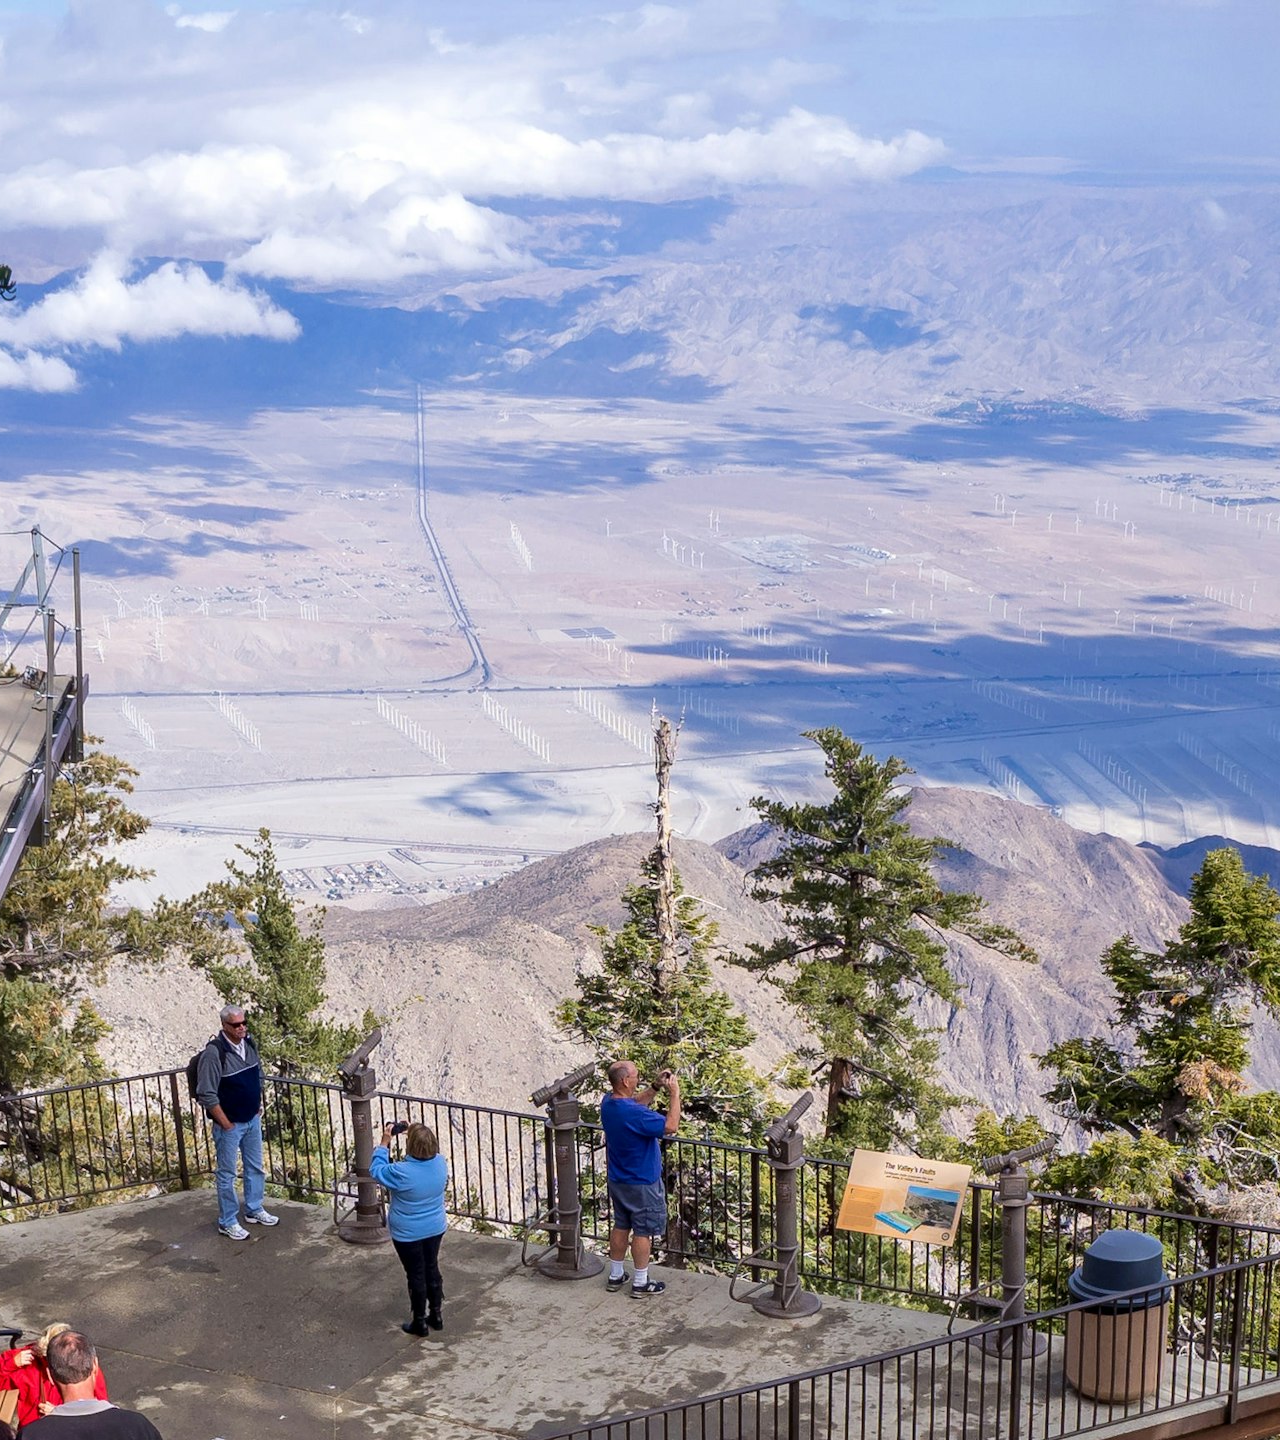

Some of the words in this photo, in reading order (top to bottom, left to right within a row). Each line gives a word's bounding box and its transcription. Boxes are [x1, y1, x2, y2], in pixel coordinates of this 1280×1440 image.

[885, 1161, 895, 1169] The
[897, 1164, 918, 1173] Valley's
[919, 1167, 936, 1175] Faults
